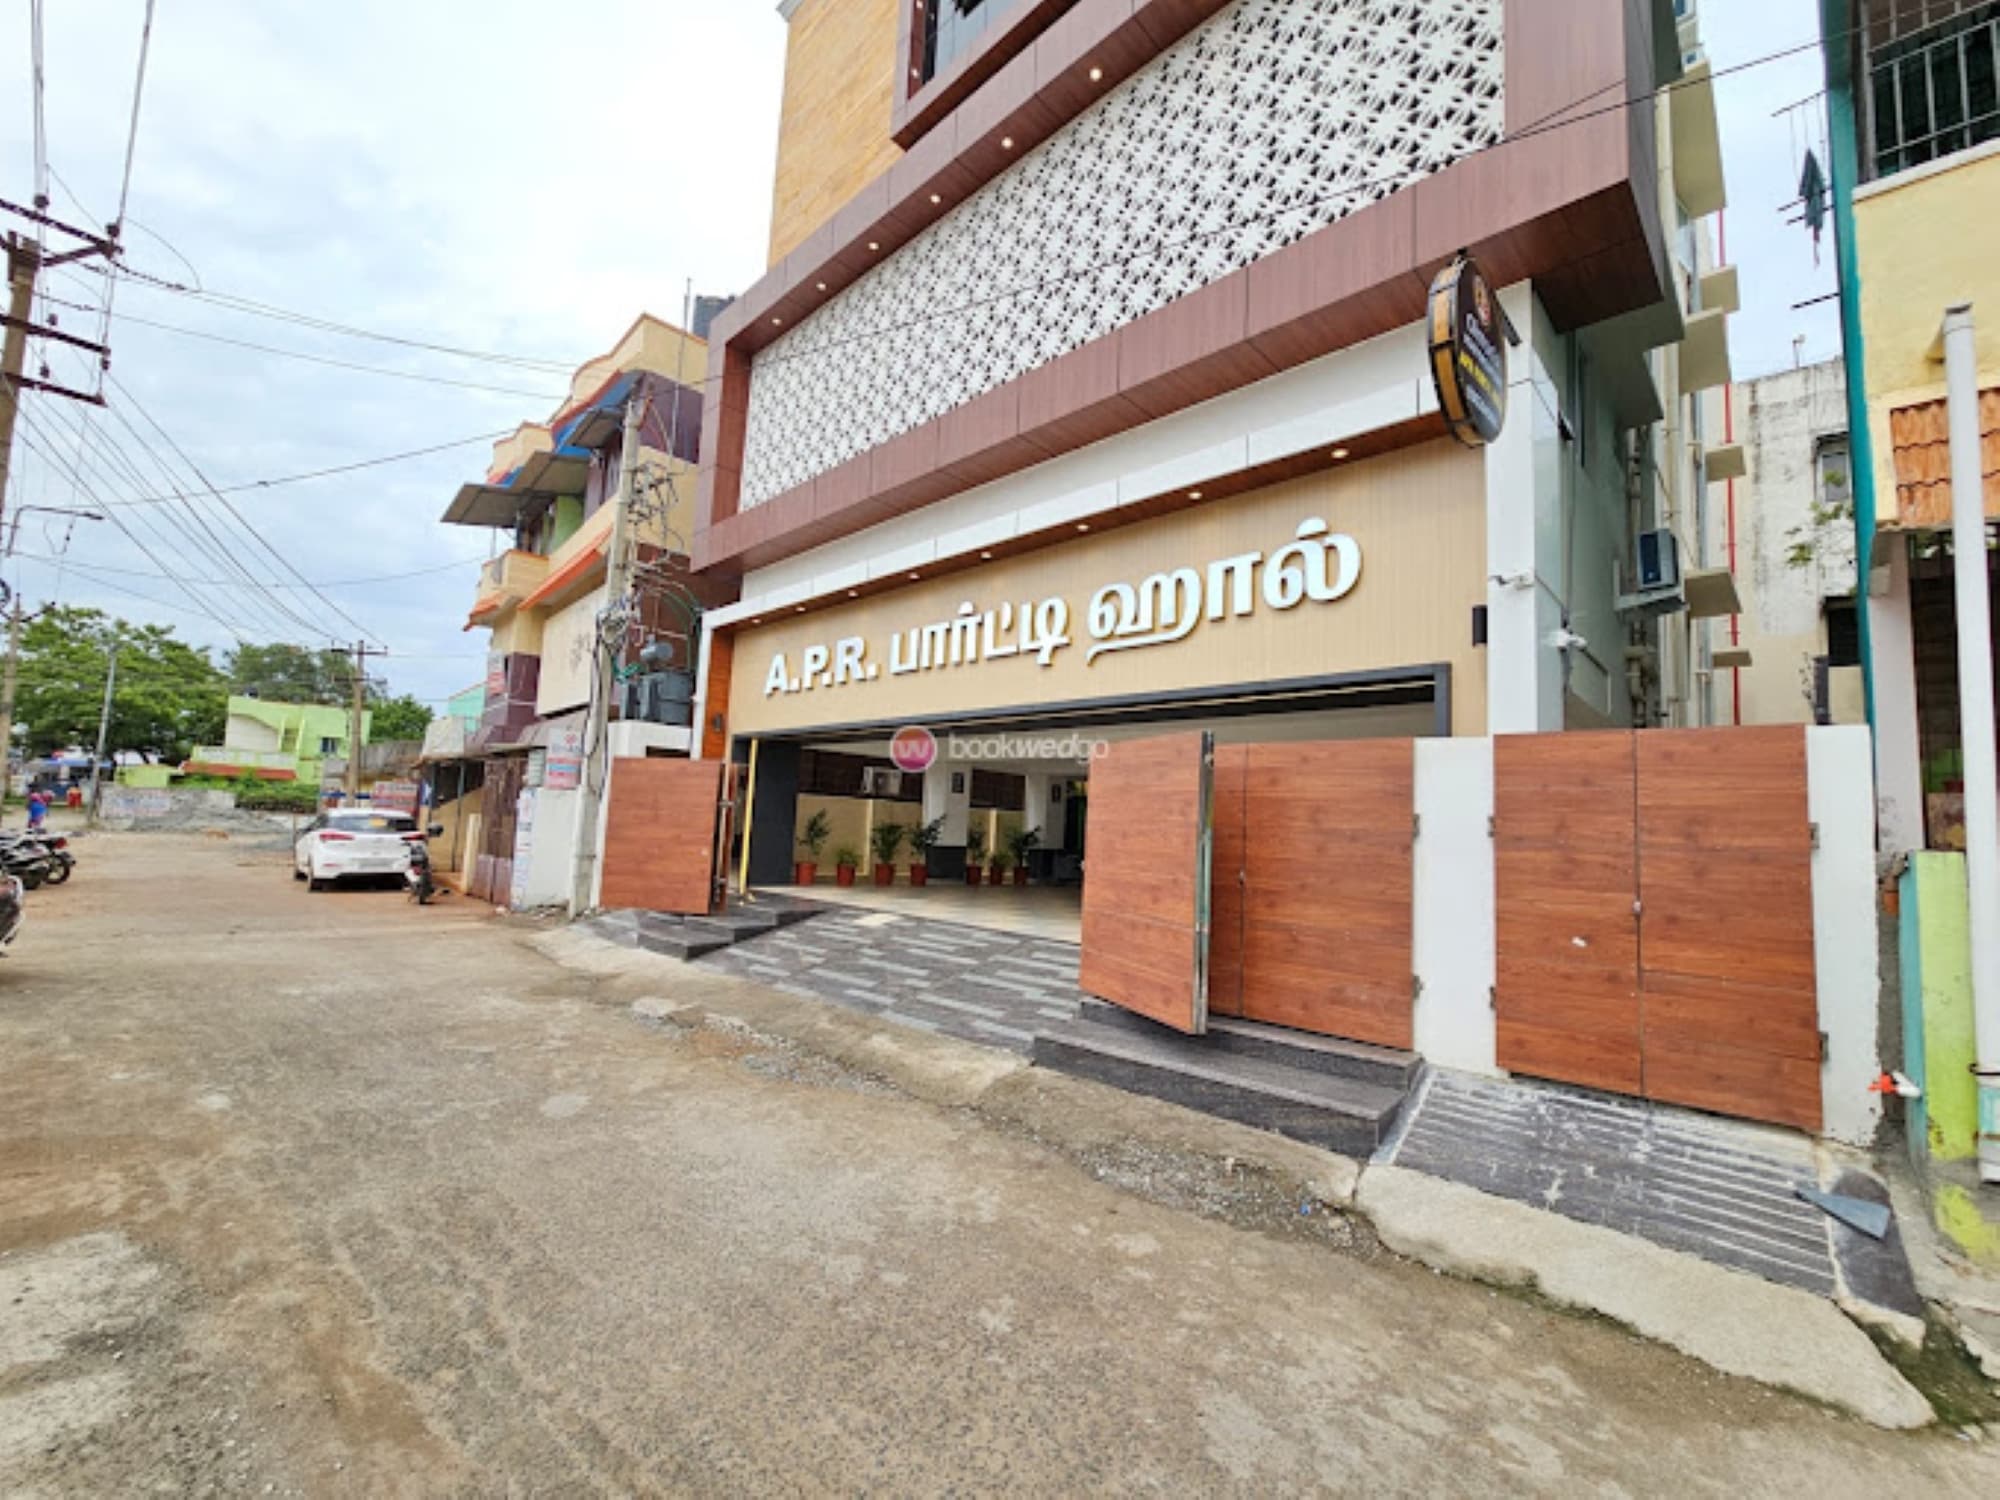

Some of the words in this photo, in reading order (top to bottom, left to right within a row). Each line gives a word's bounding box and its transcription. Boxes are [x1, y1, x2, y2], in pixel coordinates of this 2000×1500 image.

[764, 636, 879, 695] A.P.R.
[889, 598, 1071, 675] பார்ட்டி
[1085, 516, 1362, 666] ஹால்
